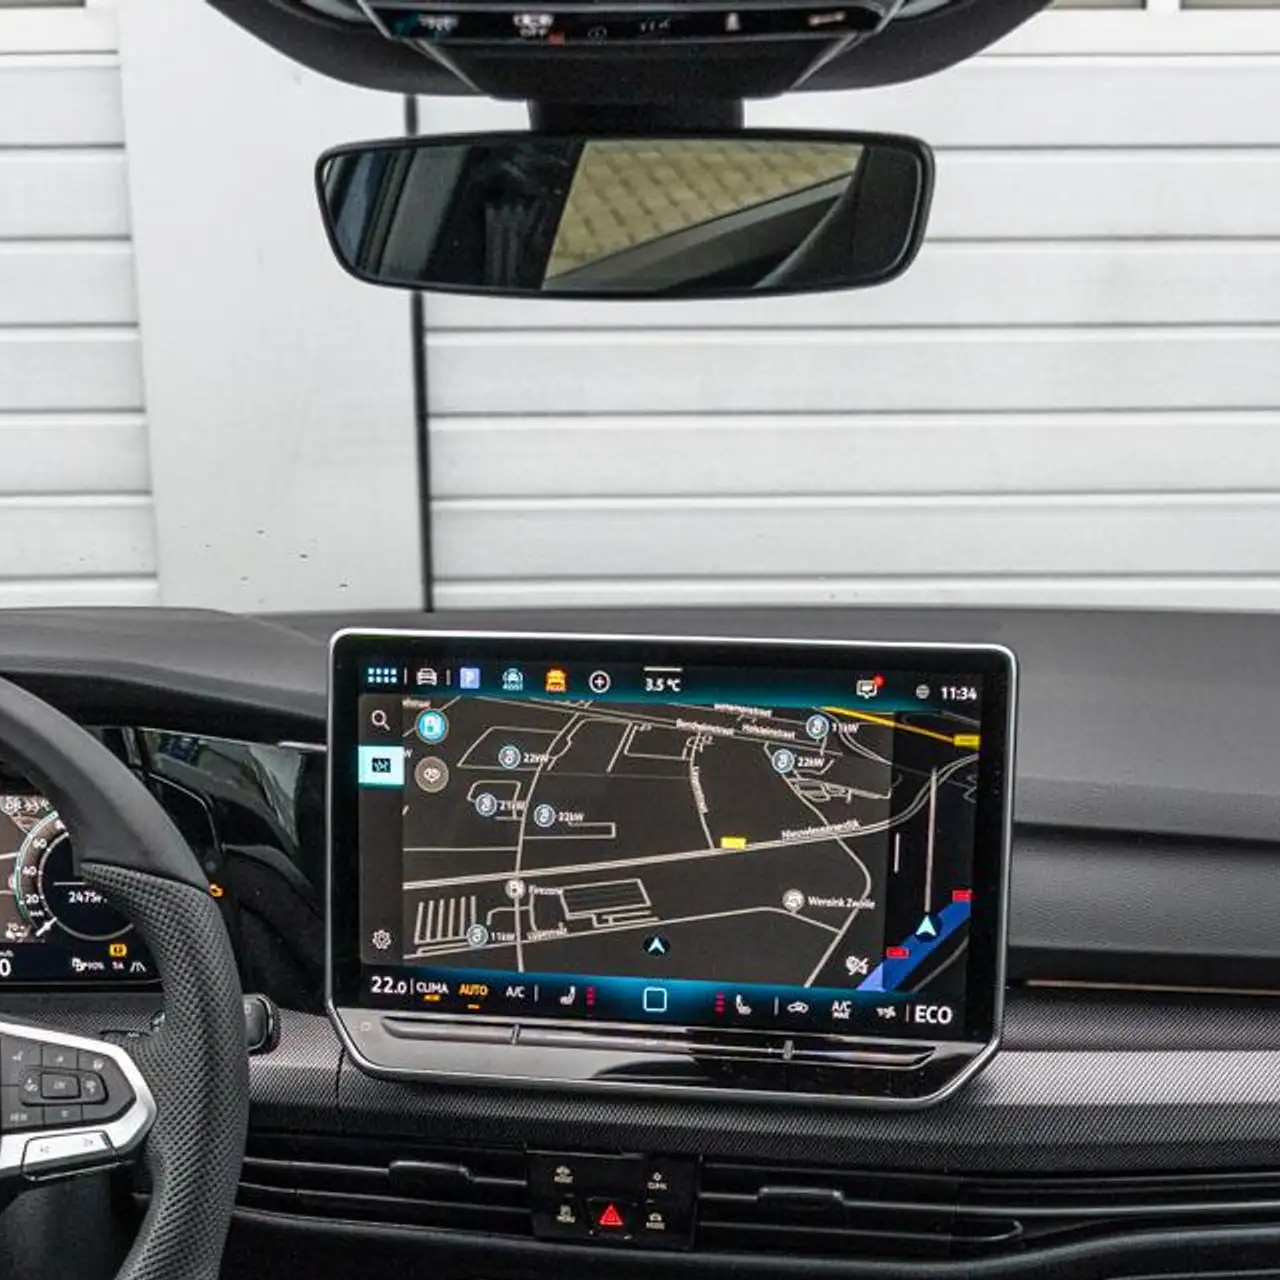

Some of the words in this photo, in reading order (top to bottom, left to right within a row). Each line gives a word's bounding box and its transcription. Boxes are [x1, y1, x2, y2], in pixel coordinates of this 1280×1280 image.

[644, 678, 665, 691] 3.5
[941, 687, 977, 701] 11:34
[797, 754, 825, 768] 22kW
[25, 893, 40, 905] 20
[371, 976, 408, 995] 22.0
[416, 979, 449, 994] CLIMA
[458, 983, 489, 997] AUTO
[505, 985, 526, 998] A/C
[914, 1005, 953, 1024] ECO
